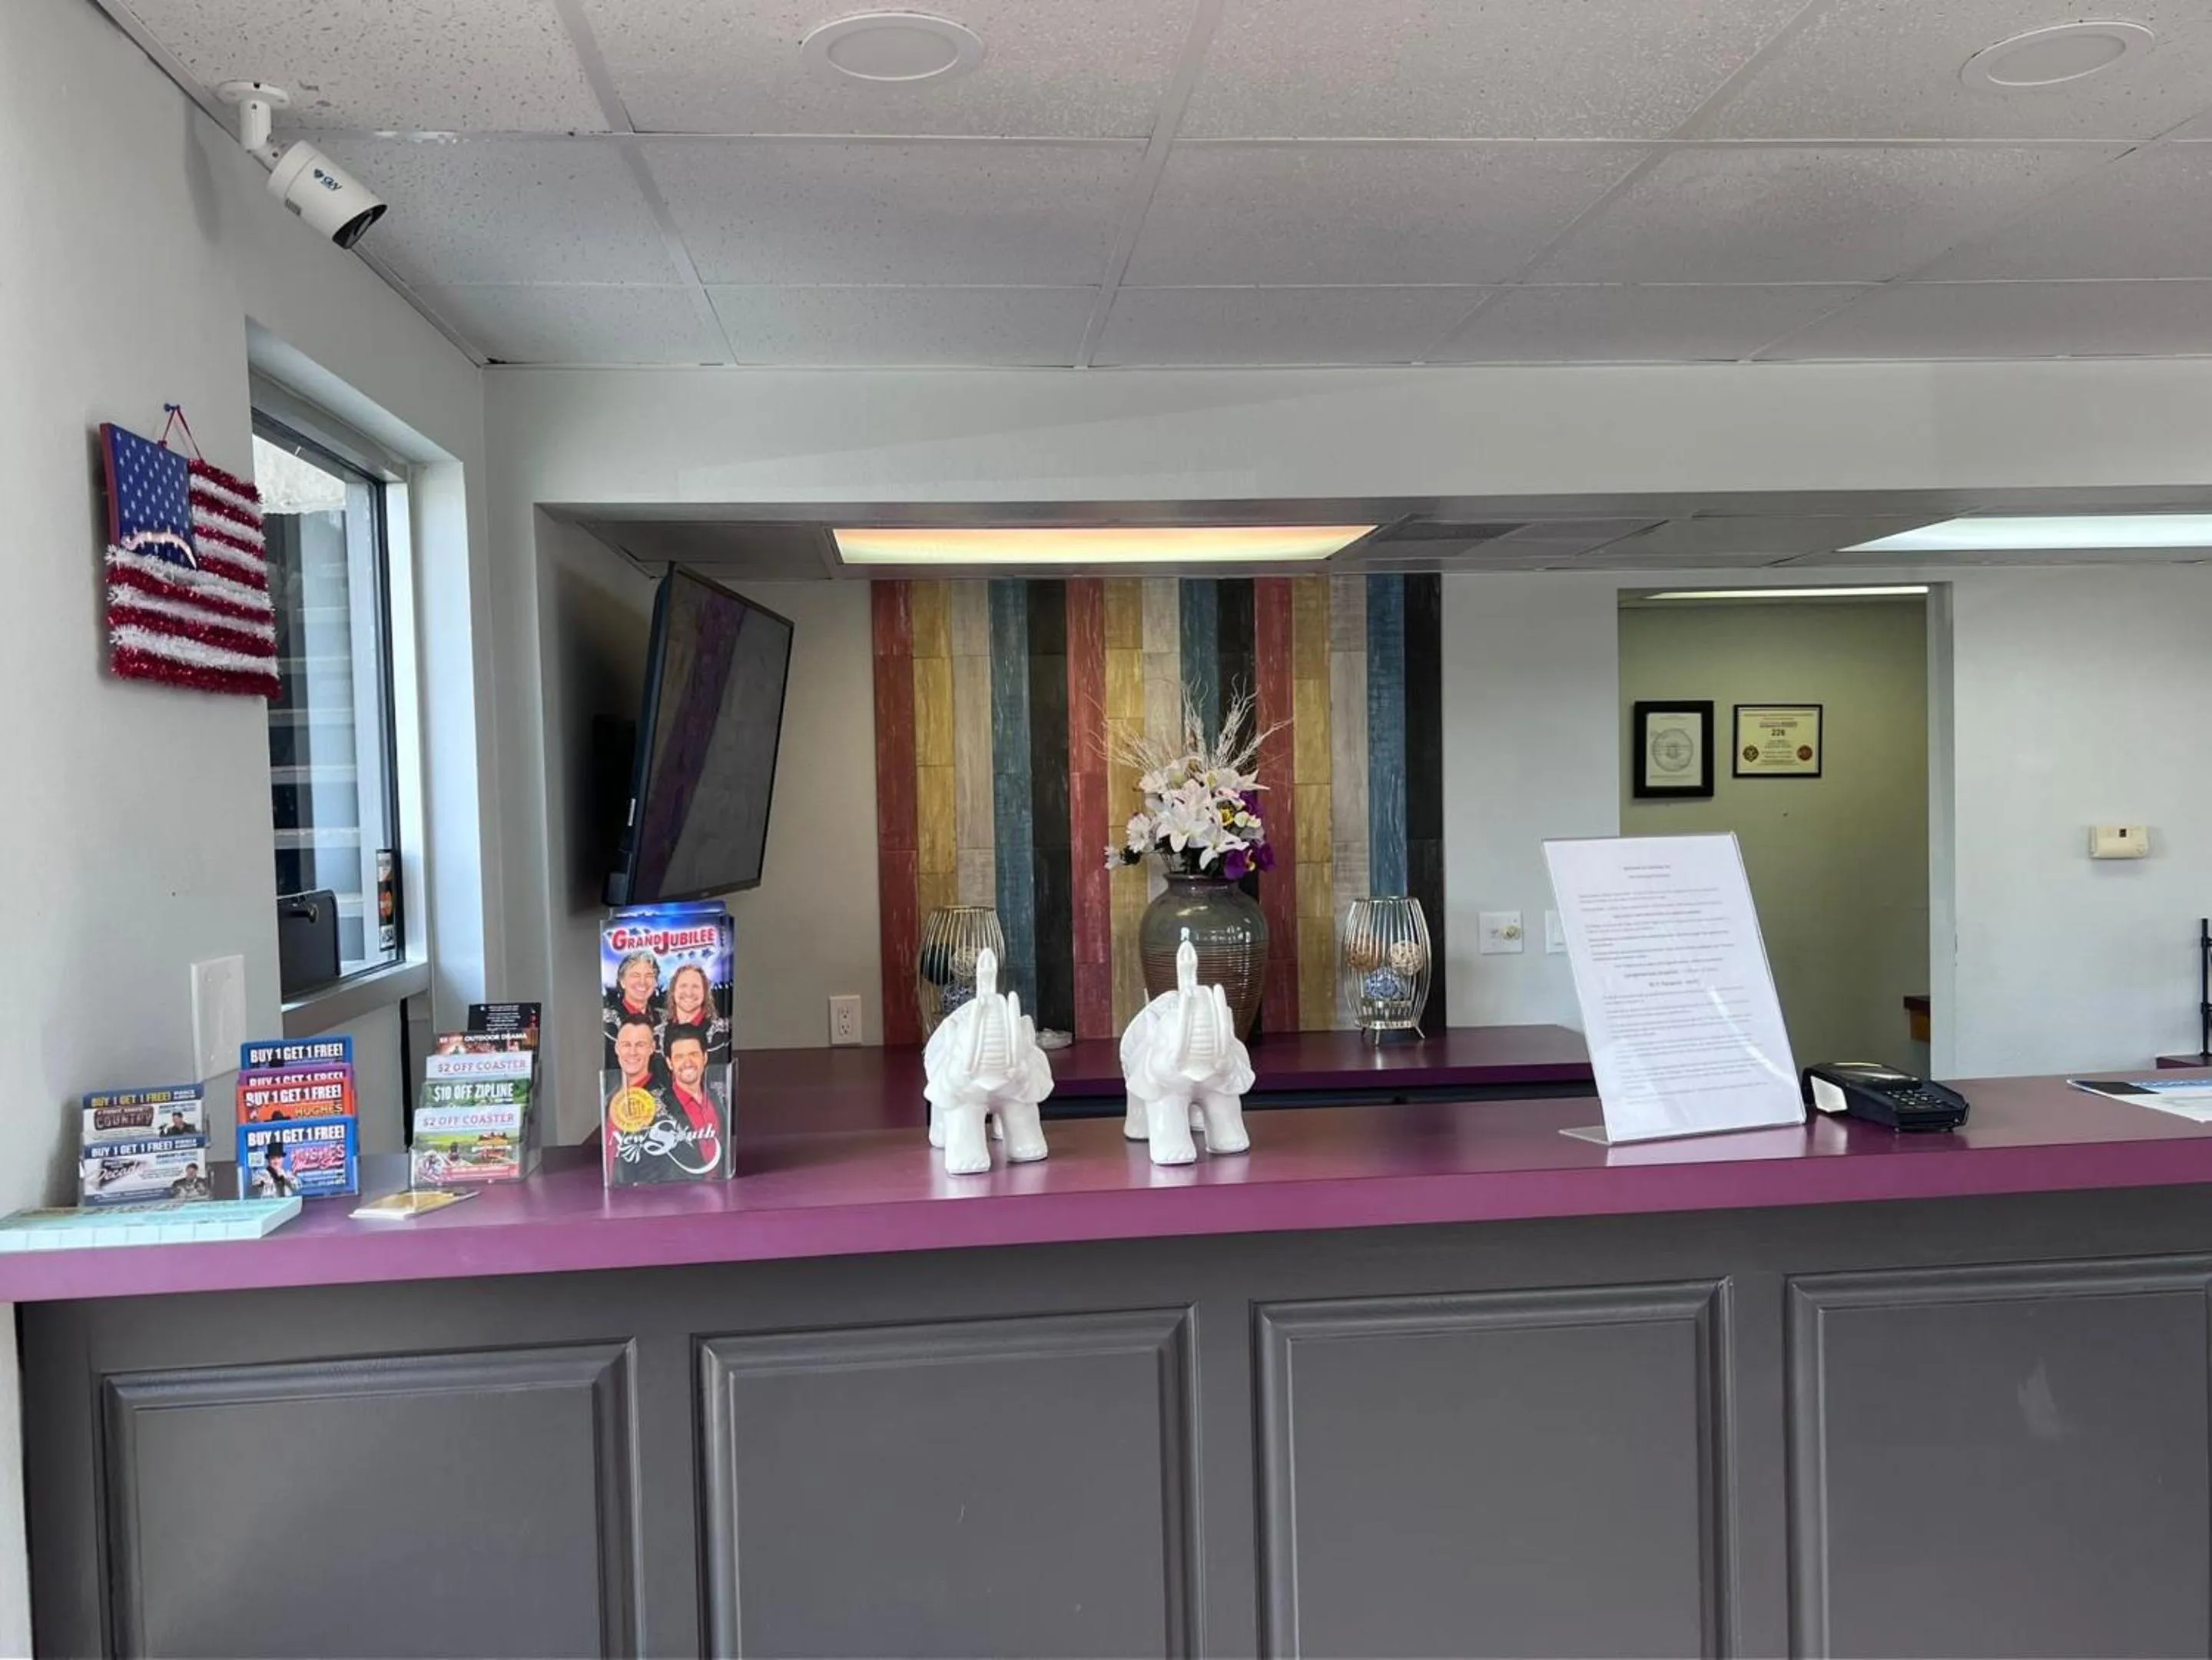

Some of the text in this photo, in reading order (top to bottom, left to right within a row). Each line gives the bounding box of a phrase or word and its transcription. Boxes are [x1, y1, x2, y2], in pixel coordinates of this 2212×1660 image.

[501, 1032, 527, 1041] DRAMA
[250, 1042, 343, 1063] BUY 1 GET 1 FREE!
[438, 1059, 526, 1073] $2 OFF COASTER
[91, 1096, 109, 1107] BUY
[119, 1095, 137, 1105] GET
[146, 1091, 171, 1102] FREE!
[246, 1084, 342, 1106] BUY 1 GET 1 FREE!
[434, 1082, 514, 1102] $10 OFF ZIPLINE
[423, 1113, 514, 1127] $2 OFF COASTER
[247, 1125, 344, 1147] BUY 1 GET 1 FREE!
[91, 1146, 110, 1157] BUY
[120, 1145, 137, 1155] GET
[147, 1141, 172, 1151] FREE!
